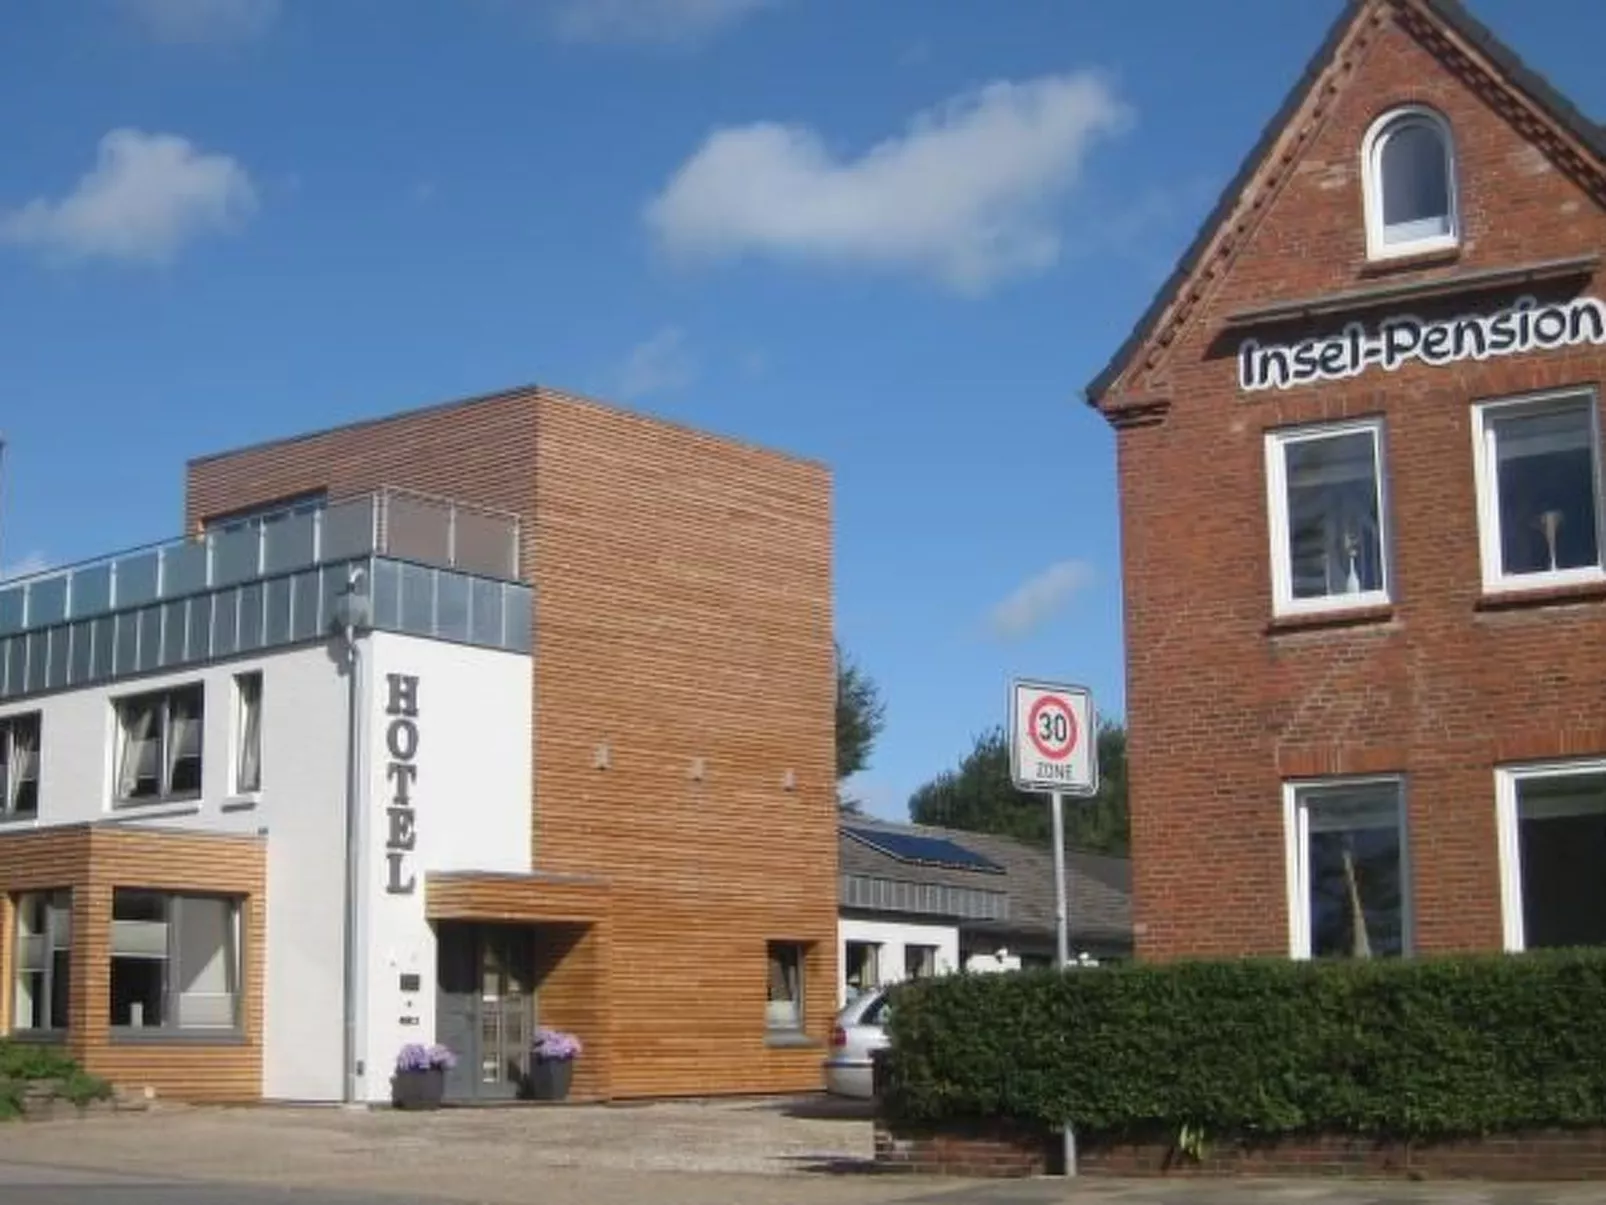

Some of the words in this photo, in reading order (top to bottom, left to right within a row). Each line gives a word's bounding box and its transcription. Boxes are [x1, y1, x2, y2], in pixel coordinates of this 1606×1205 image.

[1240, 298, 1606, 390] Insel-Pension
[1038, 712, 1067, 742] 30
[386, 673, 419, 894] HOTEL
[1036, 762, 1073, 780] ZONE
